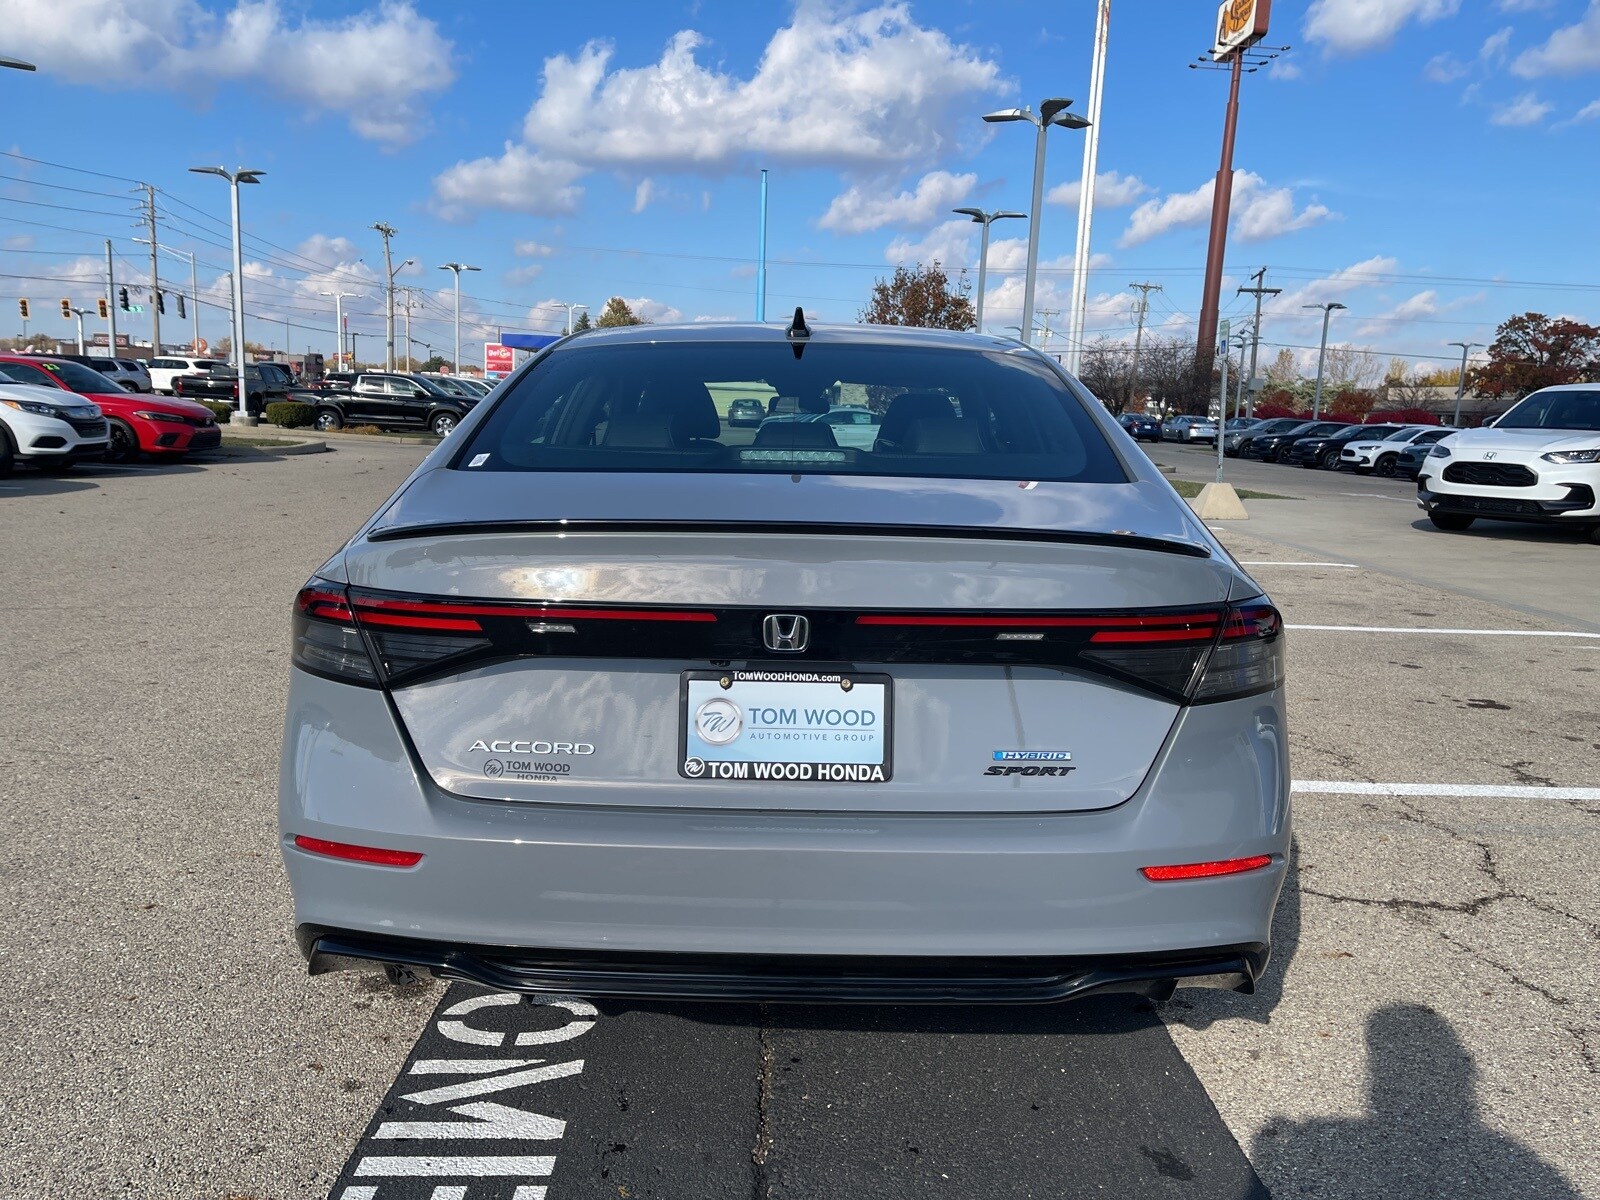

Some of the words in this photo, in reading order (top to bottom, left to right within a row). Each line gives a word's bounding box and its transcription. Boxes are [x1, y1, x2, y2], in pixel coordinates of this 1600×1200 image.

[748, 707, 797, 725] TOM
[805, 709, 876, 727] WOOD
[750, 732, 828, 741] AUTOMOTIVE
[835, 734, 875, 742] GROUP
[468, 740, 596, 755] ACCORD
[1004, 752, 1067, 760] HYBRID
[506, 760, 531, 771] TOM
[534, 762, 571, 773] WOOD
[708, 761, 748, 778] TOM
[754, 763, 812, 779] WOOD
[817, 764, 885, 781] HONDA
[983, 765, 1077, 777] SPORT
[516, 774, 558, 782] HONDA
